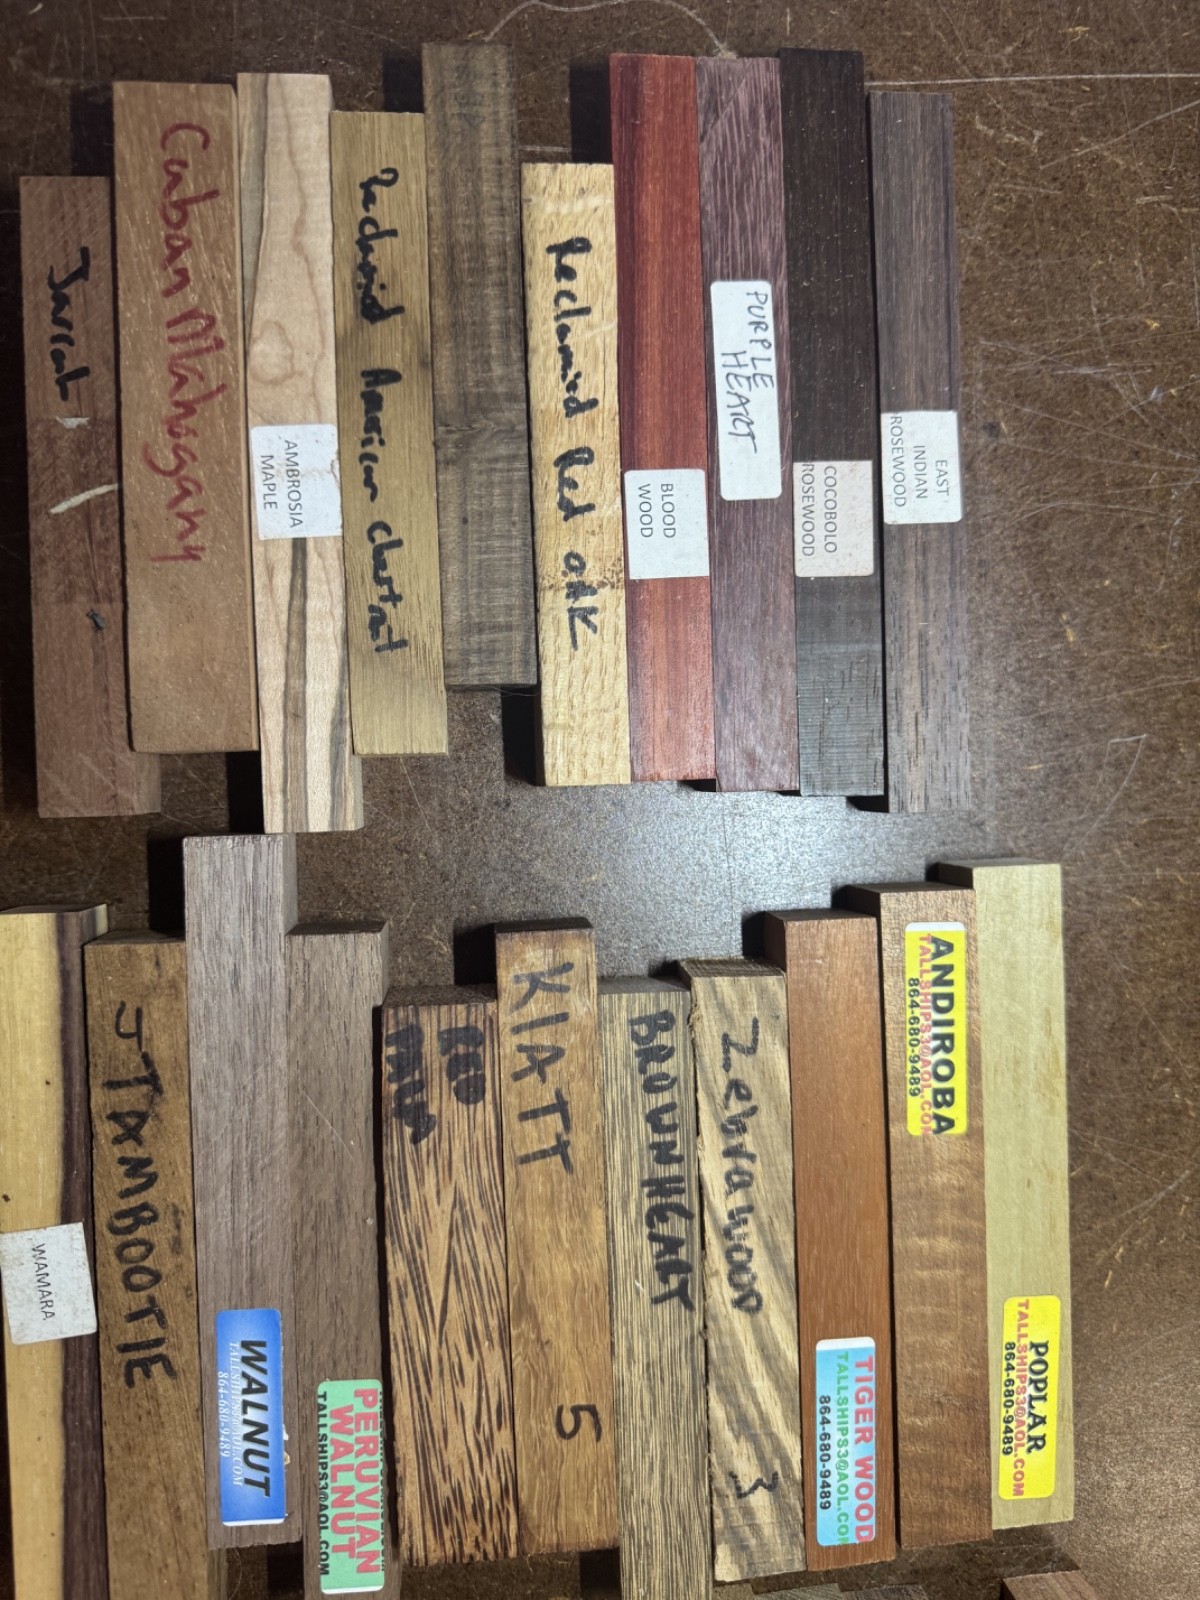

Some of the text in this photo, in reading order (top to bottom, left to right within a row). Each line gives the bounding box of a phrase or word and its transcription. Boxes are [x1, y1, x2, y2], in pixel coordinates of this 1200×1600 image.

[143, 123, 227, 562] Cuban Mahogany
[746, 291, 775, 389] PURPLE
[721, 350, 758, 454] HEART
[261, 454, 277, 510] MAPLE
[284, 439, 303, 528] AMBROSIA
[553, 446, 596, 522] Red
[638, 483, 653, 538] WOOD
[660, 483, 677, 538] BLOOD
[801, 463, 815, 557] ROSEWOOD
[824, 465, 837, 553] COCOBOLO
[890, 415, 907, 508] ROSEWOOD
[913, 445, 928, 499] INDIAN
[935, 459, 950, 496] EAST
[509, 961, 575, 1175] KIATT
[908, 977, 921, 1097] 864-680-9489
[930, 935, 956, 1135] ANDIROBA
[628, 1009, 695, 1313] BROWNHEART
[31, 1242, 56, 1321] WAMARA
[218, 1371, 232, 1458] 864-680-9489
[240, 1339, 271, 1498] WALNUT
[555, 1403, 601, 1443] 5
[1002, 1341, 1016, 1456] 864-680-9489
[1012, 1299, 1030, 1497] TALLSHIPS3@AOL.COM
[1026, 1340, 1049, 1455] POPLAR
[330, 1404, 355, 1559] WALNUT
[354, 1388, 380, 1574] PERUVIAN
[819, 1395, 831, 1510] 864-680-9489
[855, 1355, 875, 1543] TIGER WOOD
